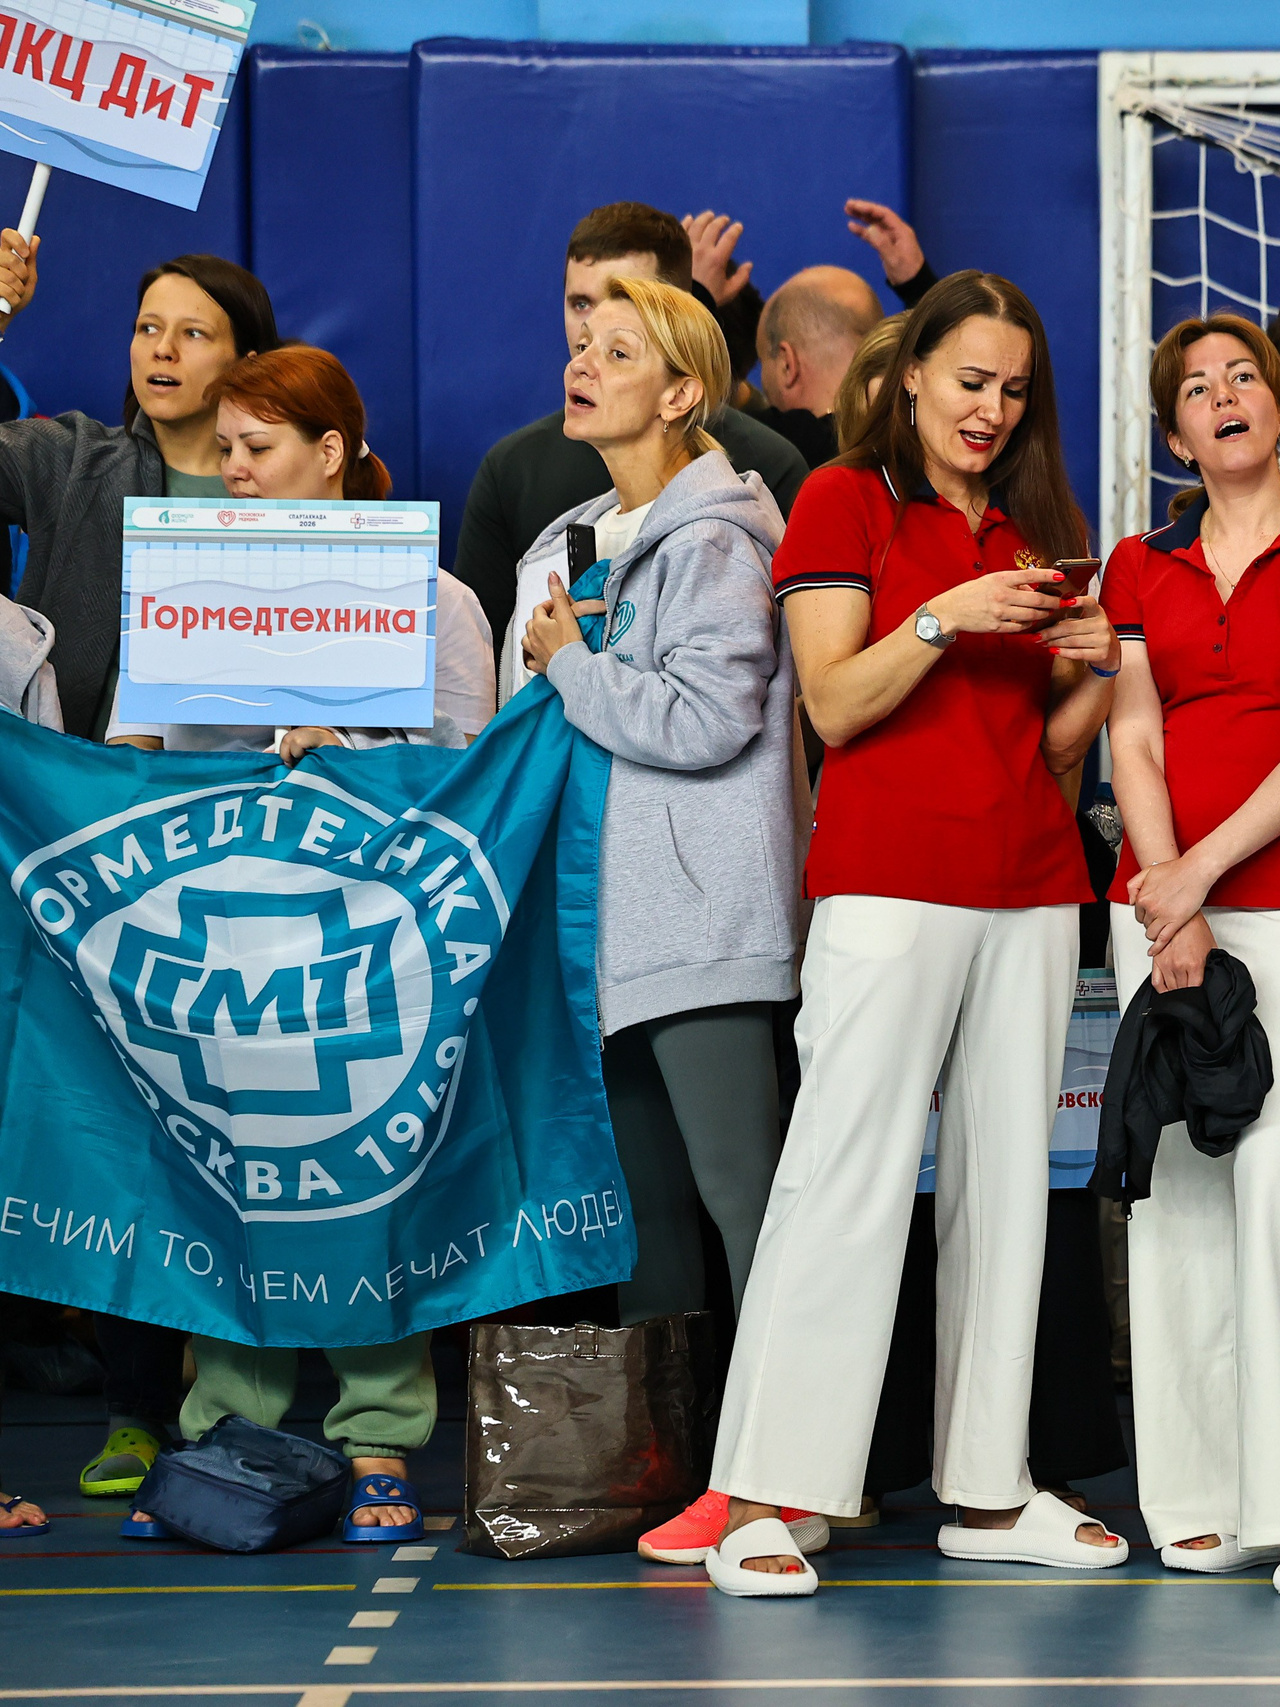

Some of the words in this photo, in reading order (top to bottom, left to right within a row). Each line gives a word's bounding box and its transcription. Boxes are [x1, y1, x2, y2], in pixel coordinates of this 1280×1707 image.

[98, 52, 215, 129] ДиТ
[299, 520, 317, 528] 2026
[140, 596, 416, 639] Гормедтехника
[0, 1196, 135, 1259] ЕЧИМ
[158, 1229, 224, 1288] ТО,
[239, 1263, 329, 1304] ЧЕМ
[347, 1222, 491, 1305] ЛЕЧАТ
